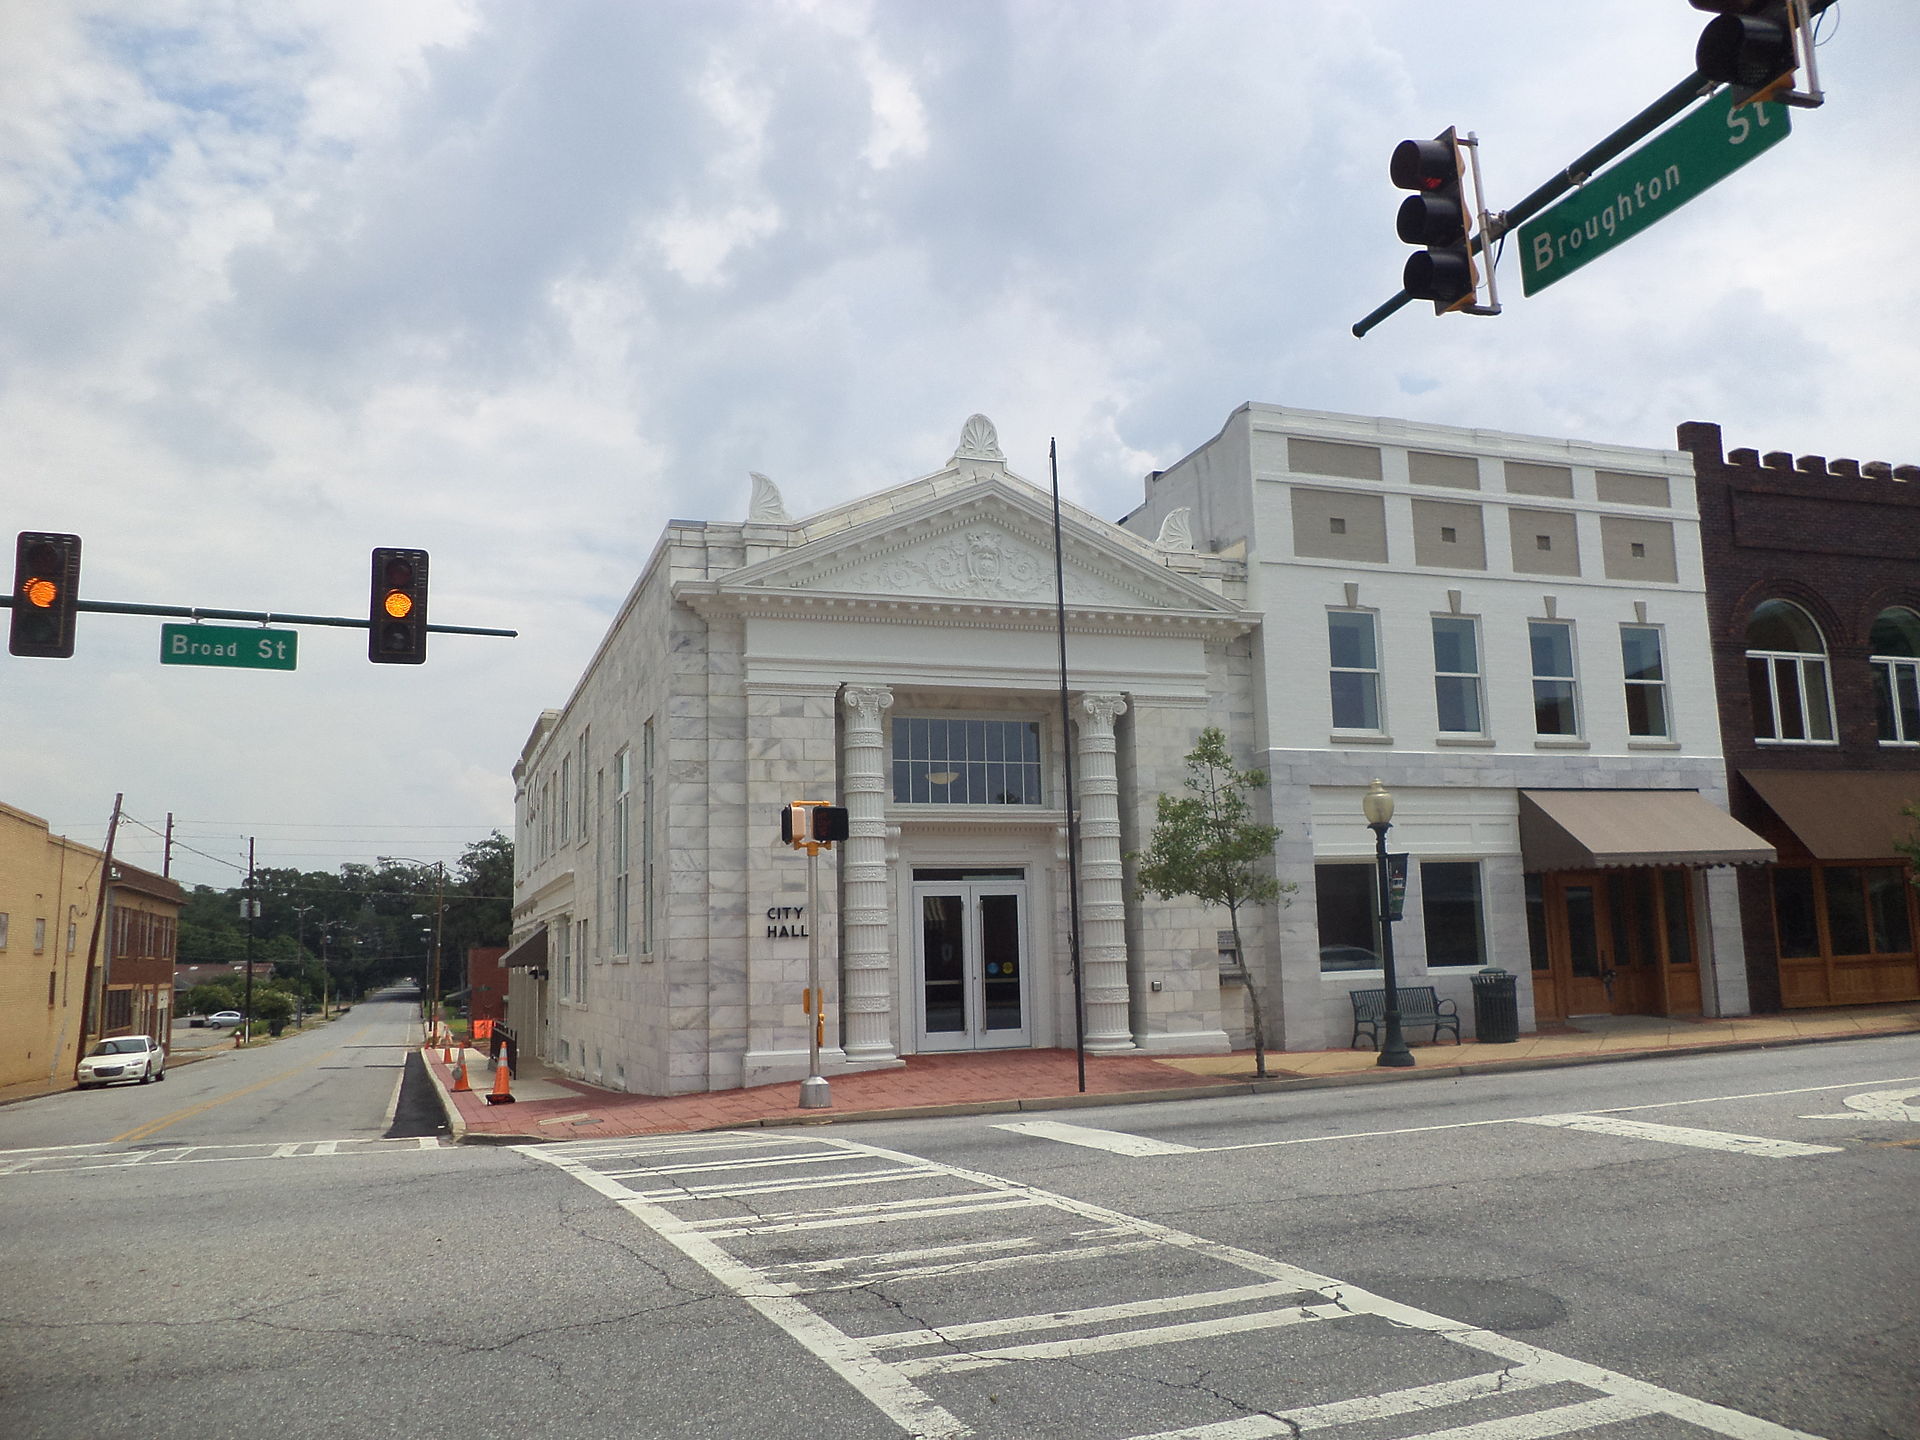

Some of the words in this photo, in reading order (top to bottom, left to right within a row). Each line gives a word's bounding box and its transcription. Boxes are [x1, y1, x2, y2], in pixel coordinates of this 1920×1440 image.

[1533, 164, 1681, 272] Broughton
[1726, 101, 1770, 145] St
[172, 634, 237, 657] Broad
[258, 639, 286, 660] St
[767, 906, 804, 920] CITY
[767, 925, 809, 938] HALL
